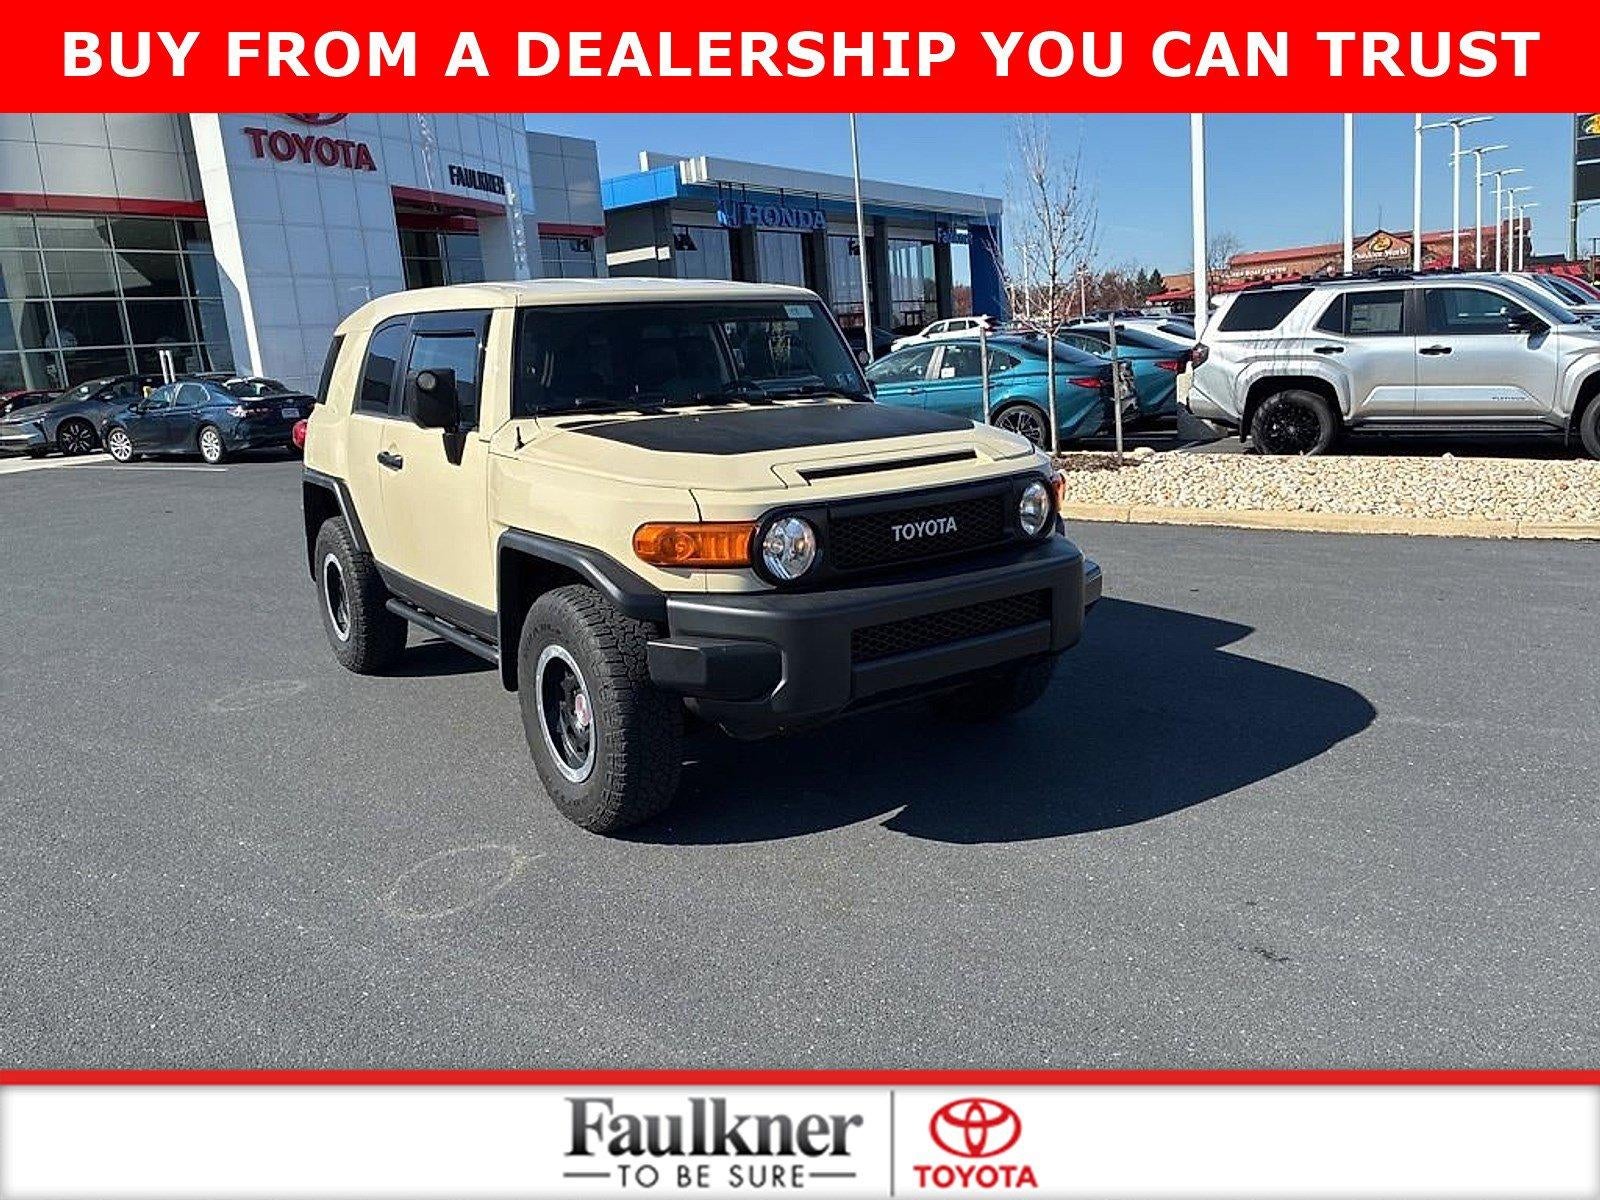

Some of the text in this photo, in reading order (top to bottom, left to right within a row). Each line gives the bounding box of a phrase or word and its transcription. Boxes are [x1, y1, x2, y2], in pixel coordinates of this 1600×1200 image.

[243, 126, 377, 171] TOYOTA
[742, 203, 826, 230] HONDA
[891, 516, 958, 541] TOYOTA
